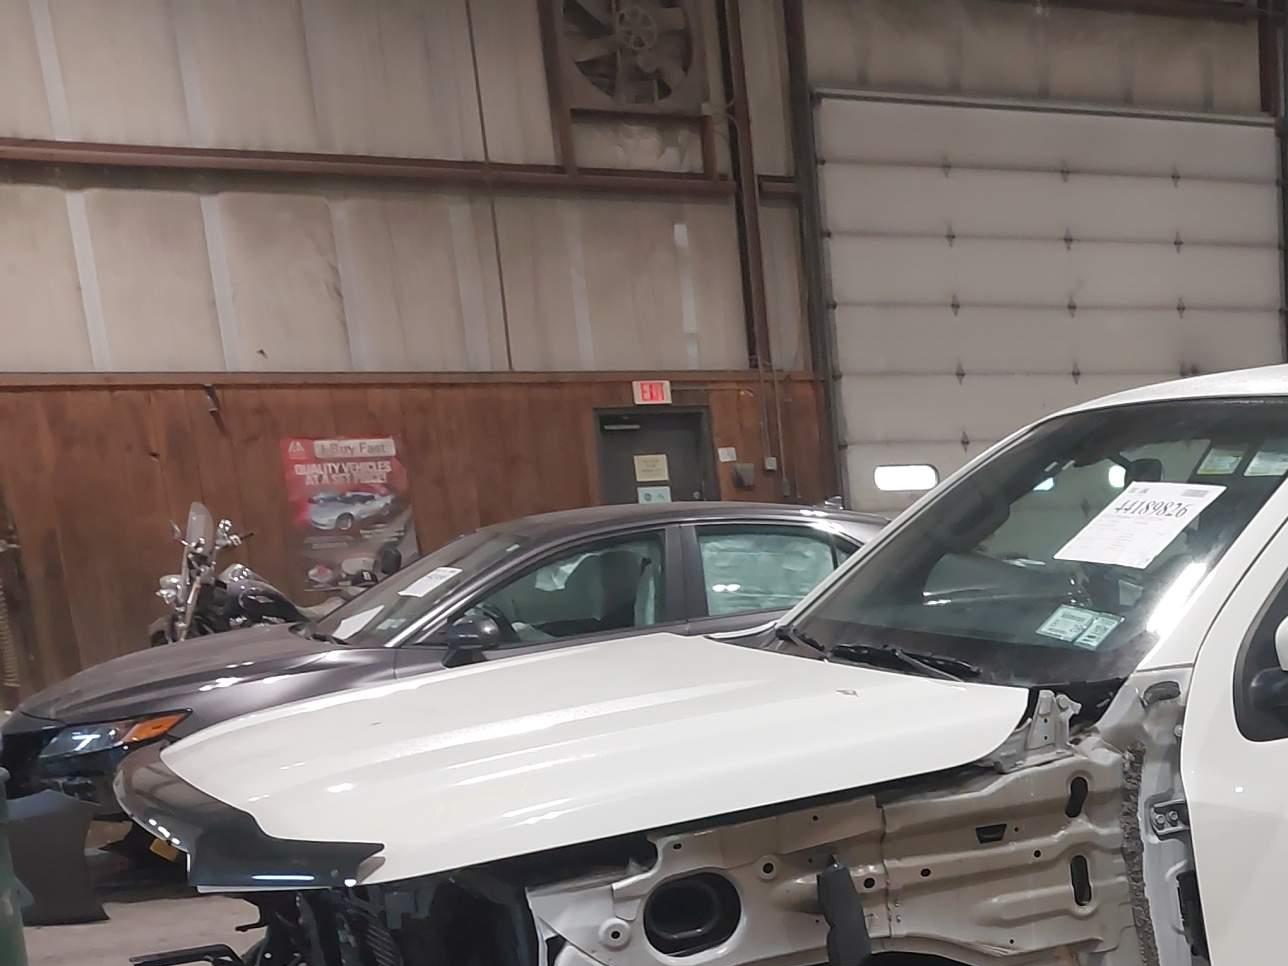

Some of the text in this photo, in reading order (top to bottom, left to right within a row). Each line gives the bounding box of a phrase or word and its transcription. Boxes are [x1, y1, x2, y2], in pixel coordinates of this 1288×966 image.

[294, 461, 392, 475] QUALITY VEHICLES
[1114, 499, 1191, 519] 44189826
